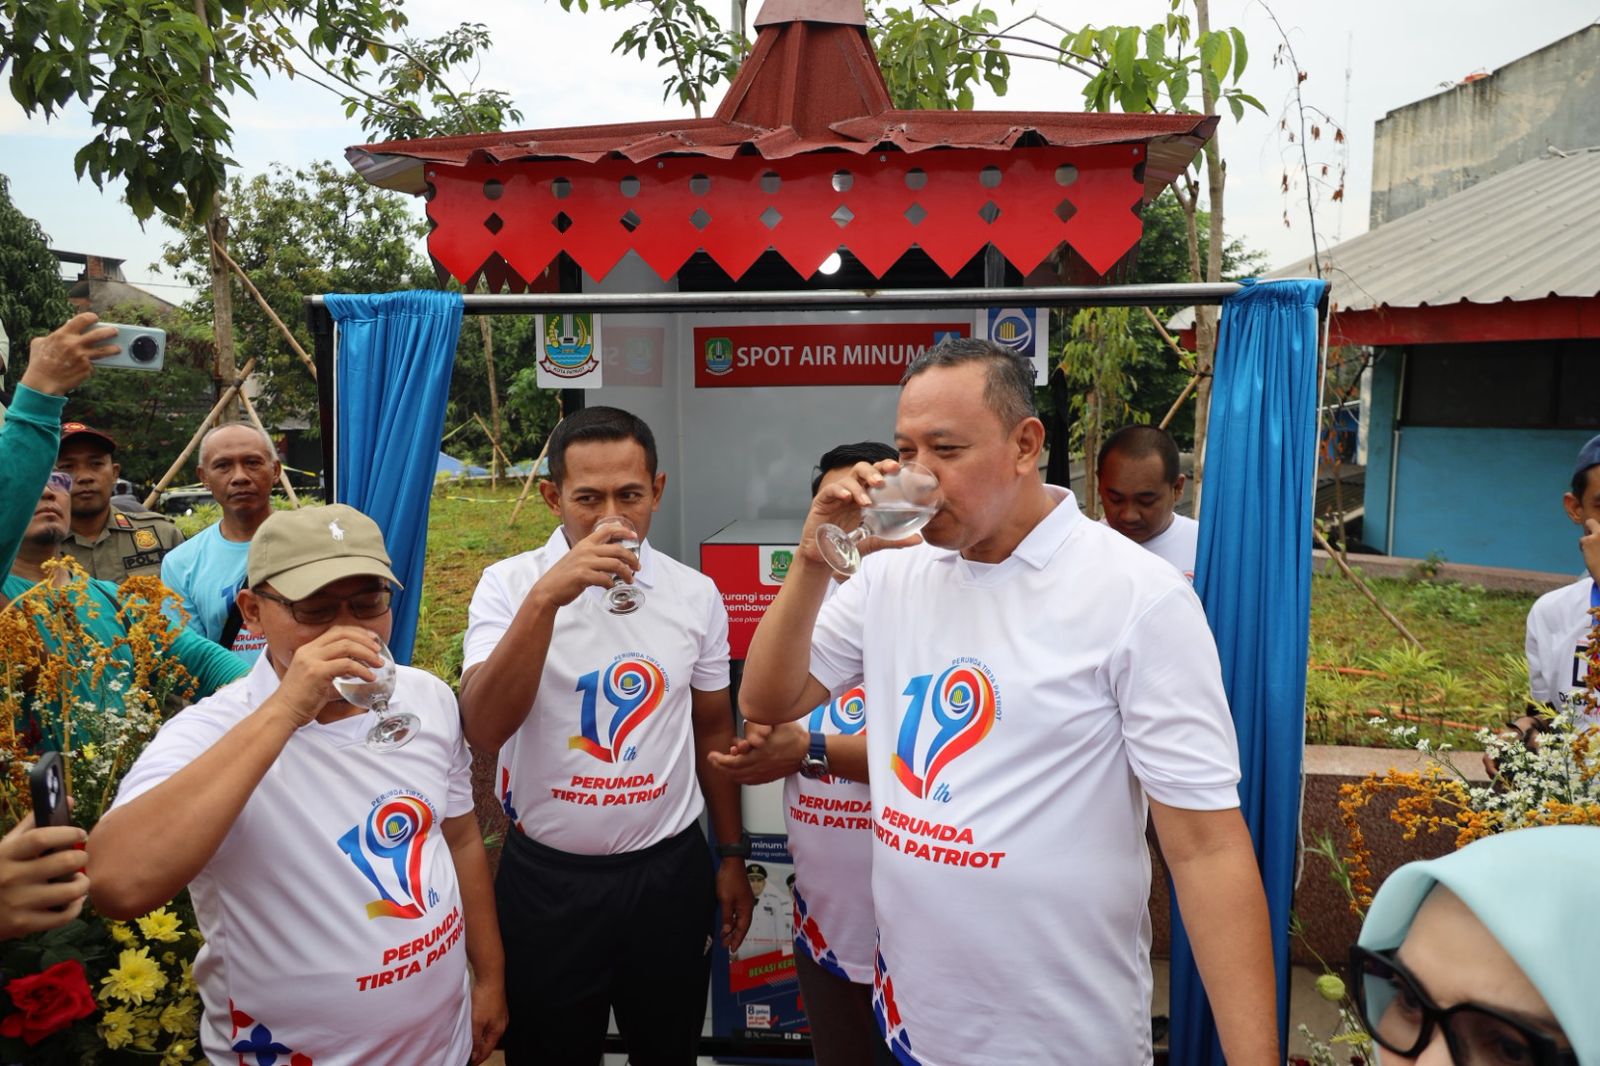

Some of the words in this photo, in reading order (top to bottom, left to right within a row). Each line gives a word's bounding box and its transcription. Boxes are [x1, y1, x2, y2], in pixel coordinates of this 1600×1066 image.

[737, 345, 794, 367] SPOT
[799, 345, 838, 366] AIR
[842, 344, 926, 366] MINUM
[614, 651, 645, 661] PERUMDA
[951, 656, 981, 667] PERUMDA
[993, 684, 1002, 720] PATRIOT
[571, 773, 654, 790] PERUMDA
[371, 789, 403, 807] PERUMDA
[551, 788, 598, 806] TIRTA
[602, 783, 668, 807] PATRIOT
[799, 793, 872, 814] PERUMDA
[789, 806, 819, 826] TIRTA
[882, 805, 974, 845] PERUMDA
[872, 820, 900, 851] TIRTA
[904, 839, 1006, 869] PATRIOT
[383, 905, 459, 966] PERUMDA
[356, 959, 422, 992] TIRTA
[749, 963, 776, 978] BEKASI
[748, 1005, 755, 1015] 8
